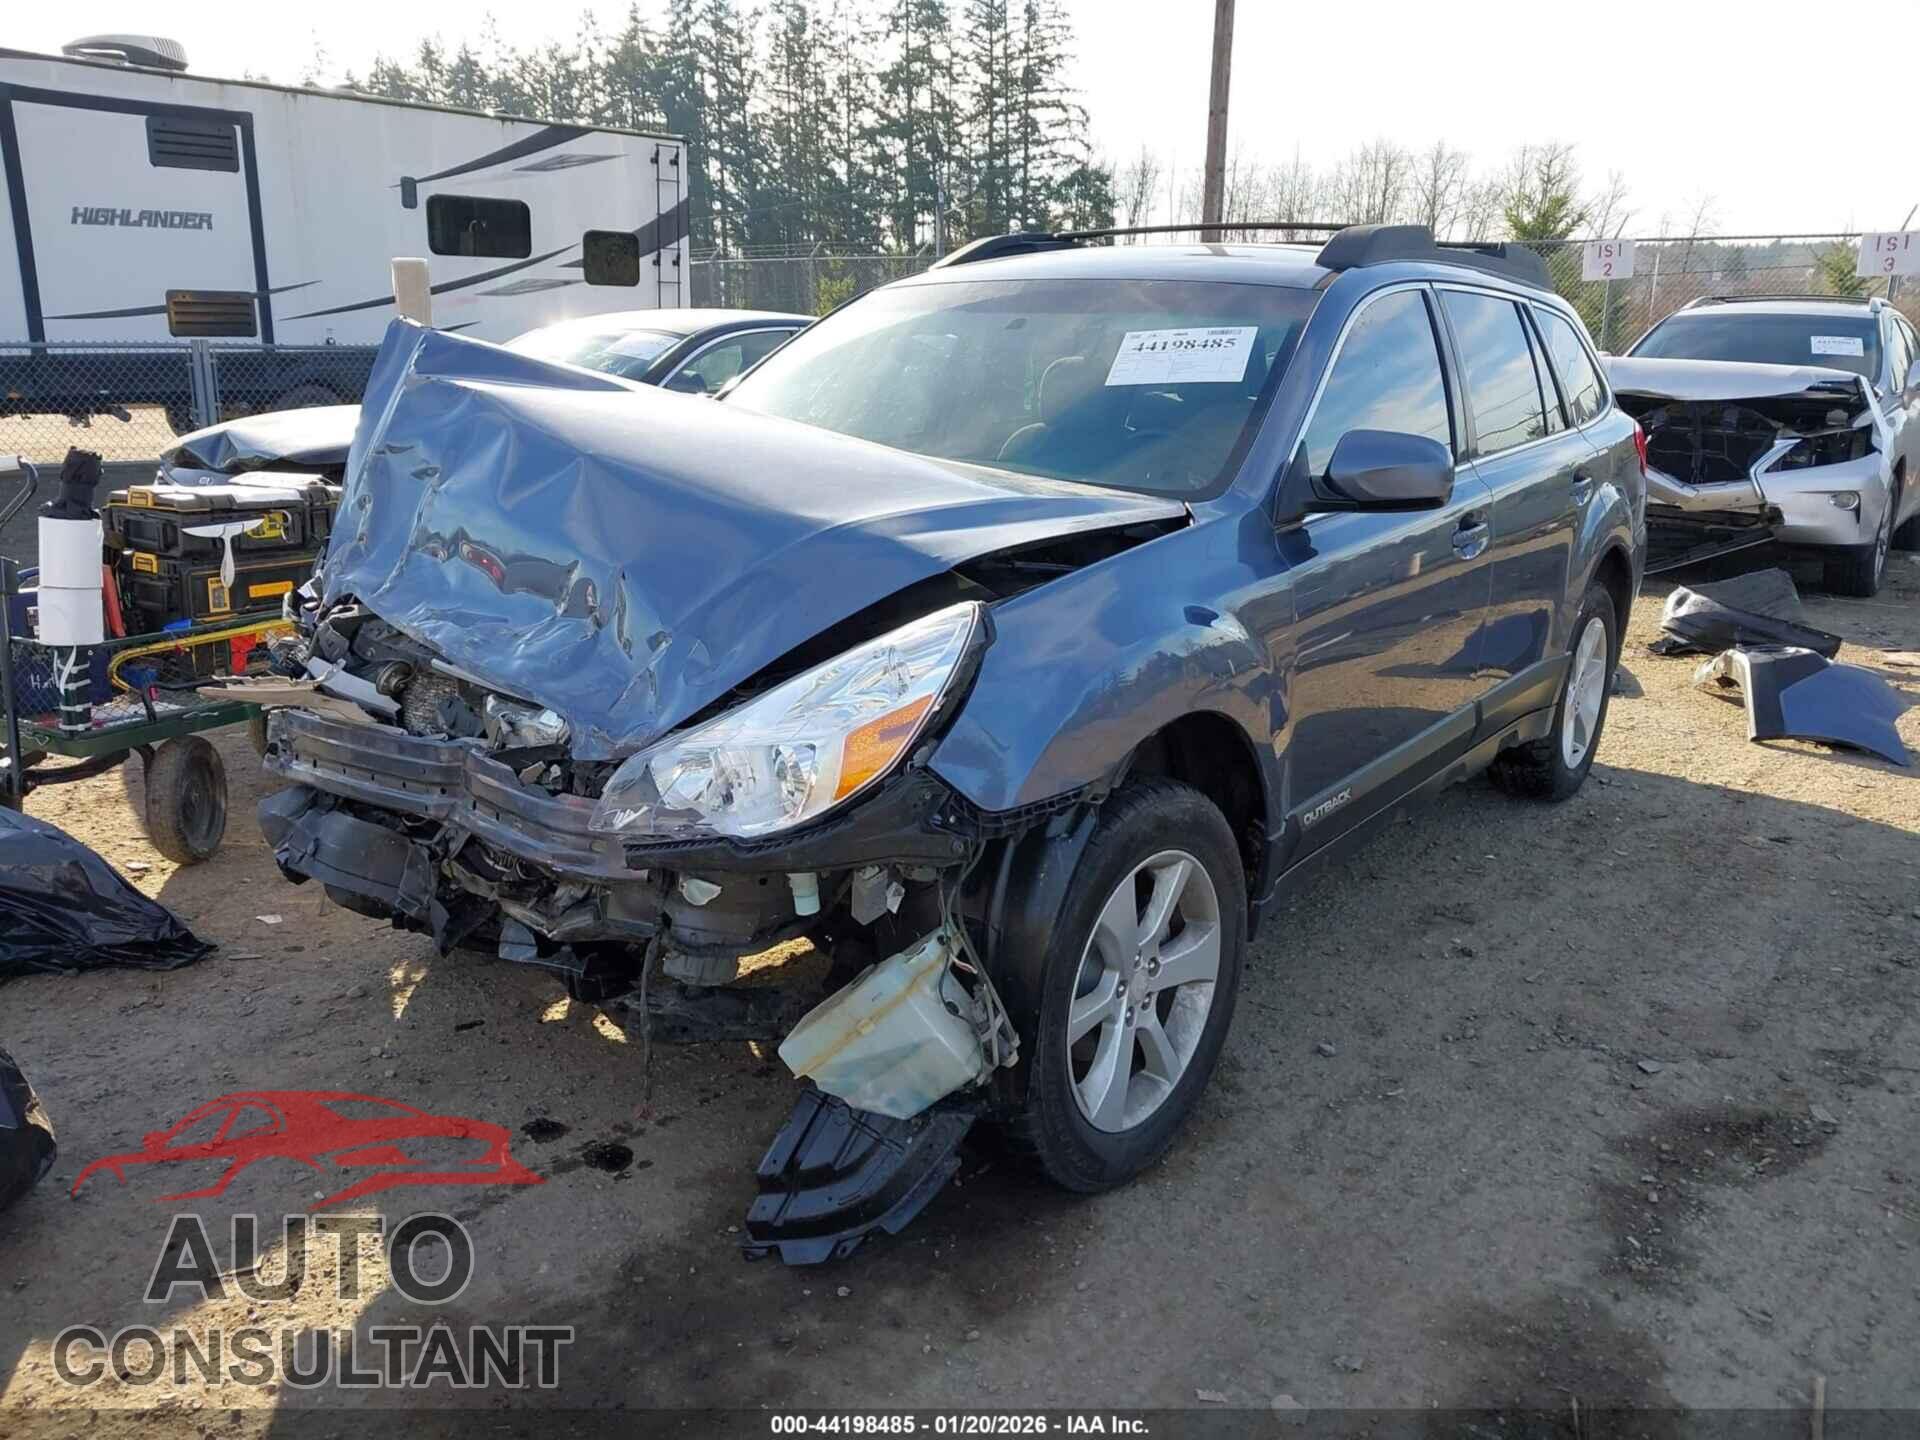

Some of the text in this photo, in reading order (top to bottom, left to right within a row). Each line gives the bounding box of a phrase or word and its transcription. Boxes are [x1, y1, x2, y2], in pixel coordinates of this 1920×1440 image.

[71, 206, 213, 231] HIGHLANDER
[1603, 262, 1612, 276] 2
[1884, 256, 1895, 272] 3
[1131, 337, 1237, 352] 44198485
[1303, 787, 1352, 825] OUTBACK
